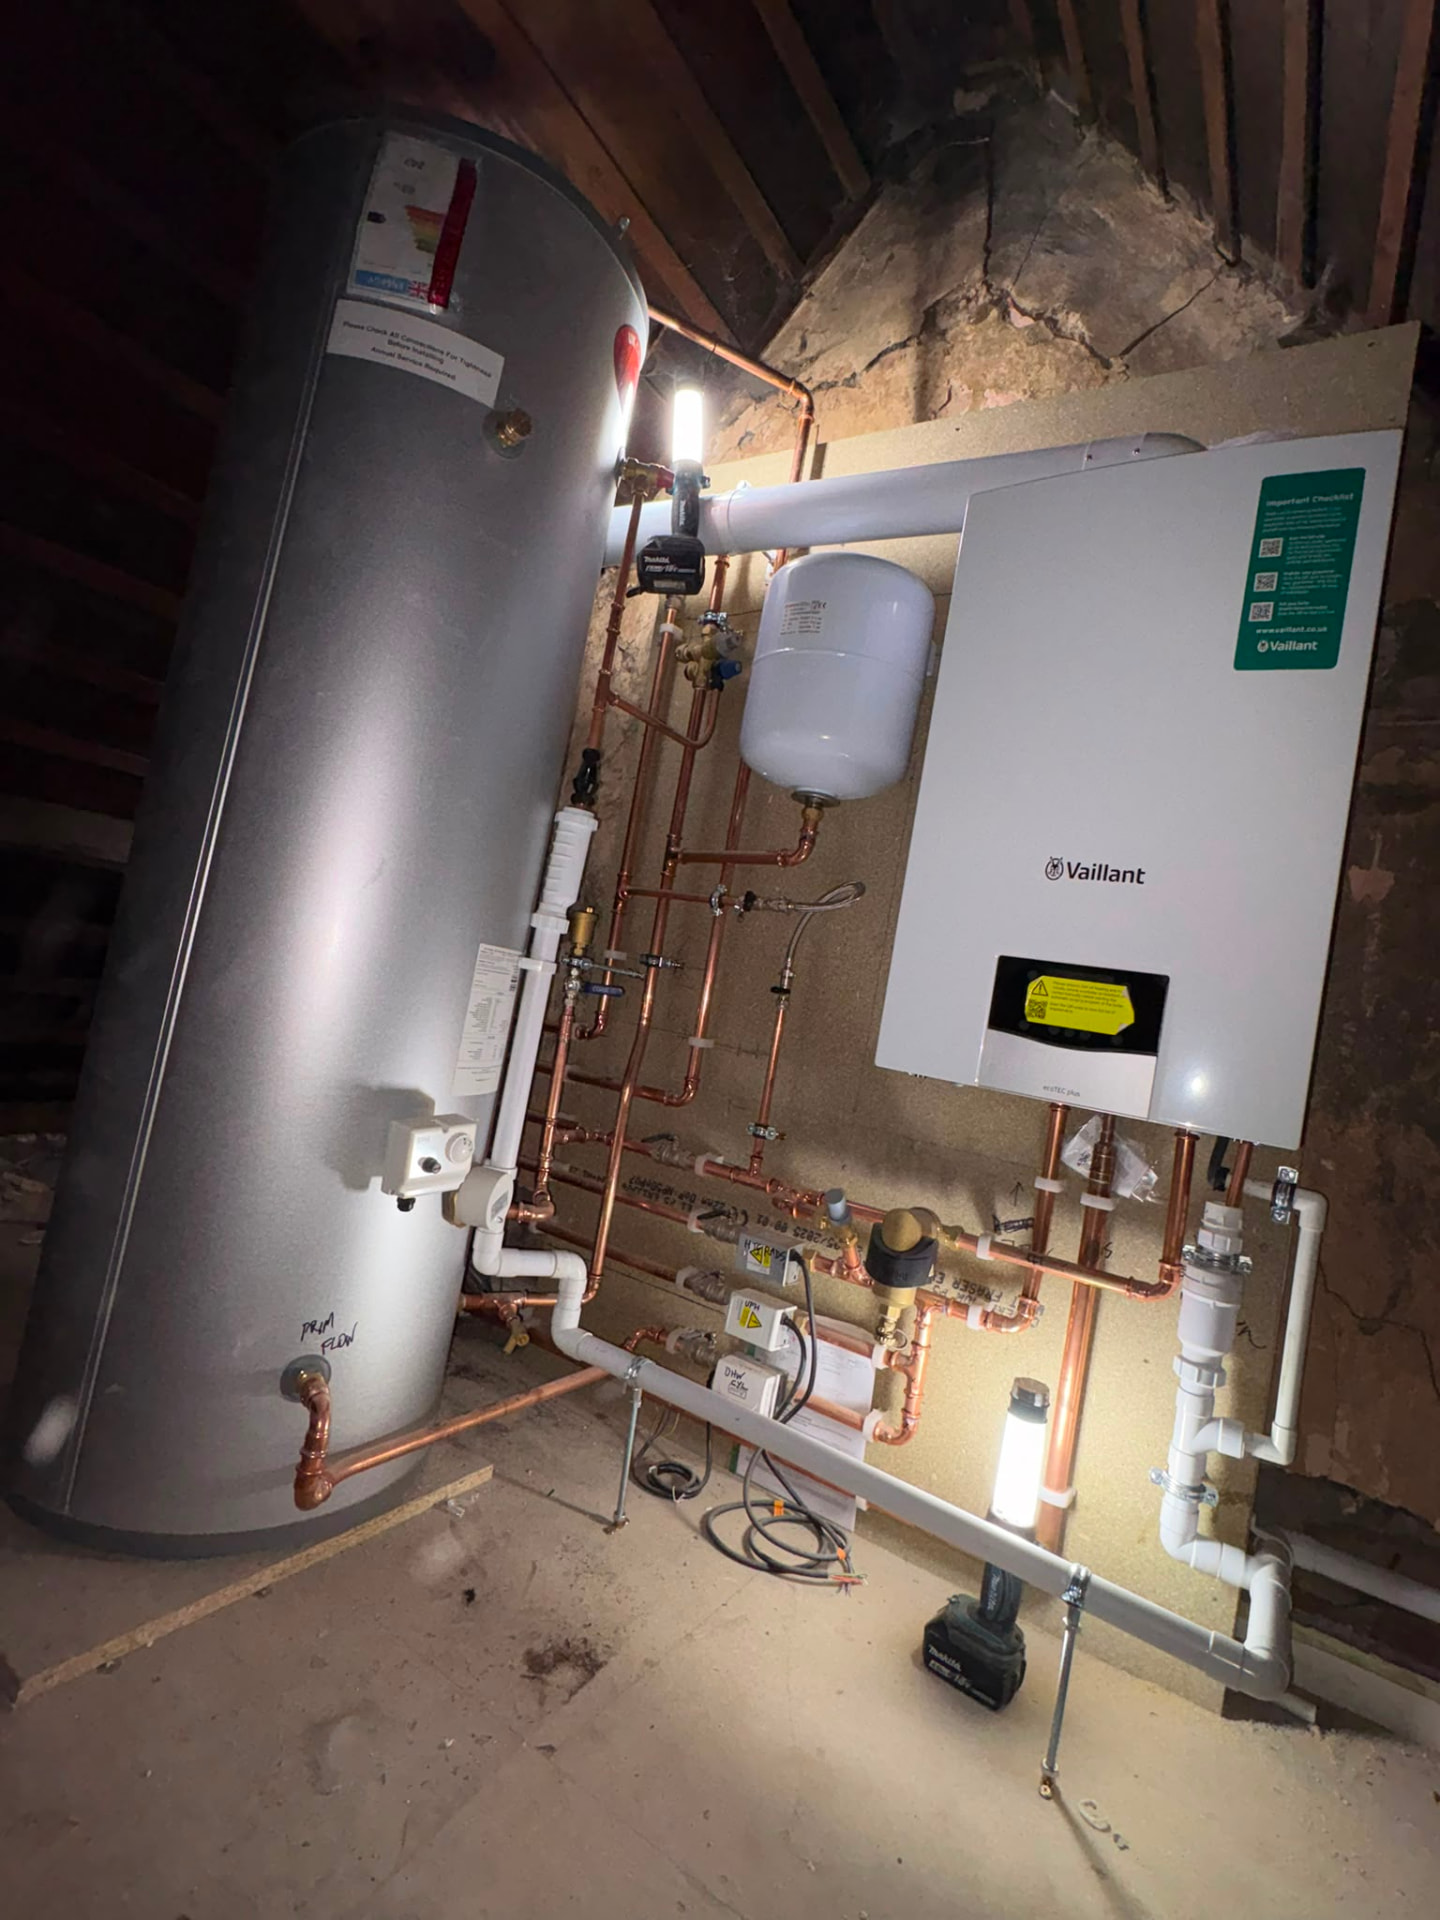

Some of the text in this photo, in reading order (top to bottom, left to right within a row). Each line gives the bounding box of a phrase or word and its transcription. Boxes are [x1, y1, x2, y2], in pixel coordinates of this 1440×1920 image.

[366, 325, 387, 336] Check
[389, 331, 399, 339] All
[401, 334, 445, 355] Connections
[446, 350, 458, 361] For
[387, 339, 444, 365] Before Installing
[371, 346, 456, 381] Annual Service Required
[1266, 492, 1354, 507] Important Checklist
[1270, 640, 1318, 652] Vaillant
[1066, 861, 1146, 885] Vaillant
[1042, 1084, 1081, 1098] ecoTEC plus
[952, 1277, 1003, 1303] FRASER
[300, 1312, 335, 1342] PRIM
[321, 1322, 359, 1355] FLOW
[724, 1366, 747, 1380] DHW
[730, 1379, 749, 1392] CYL
